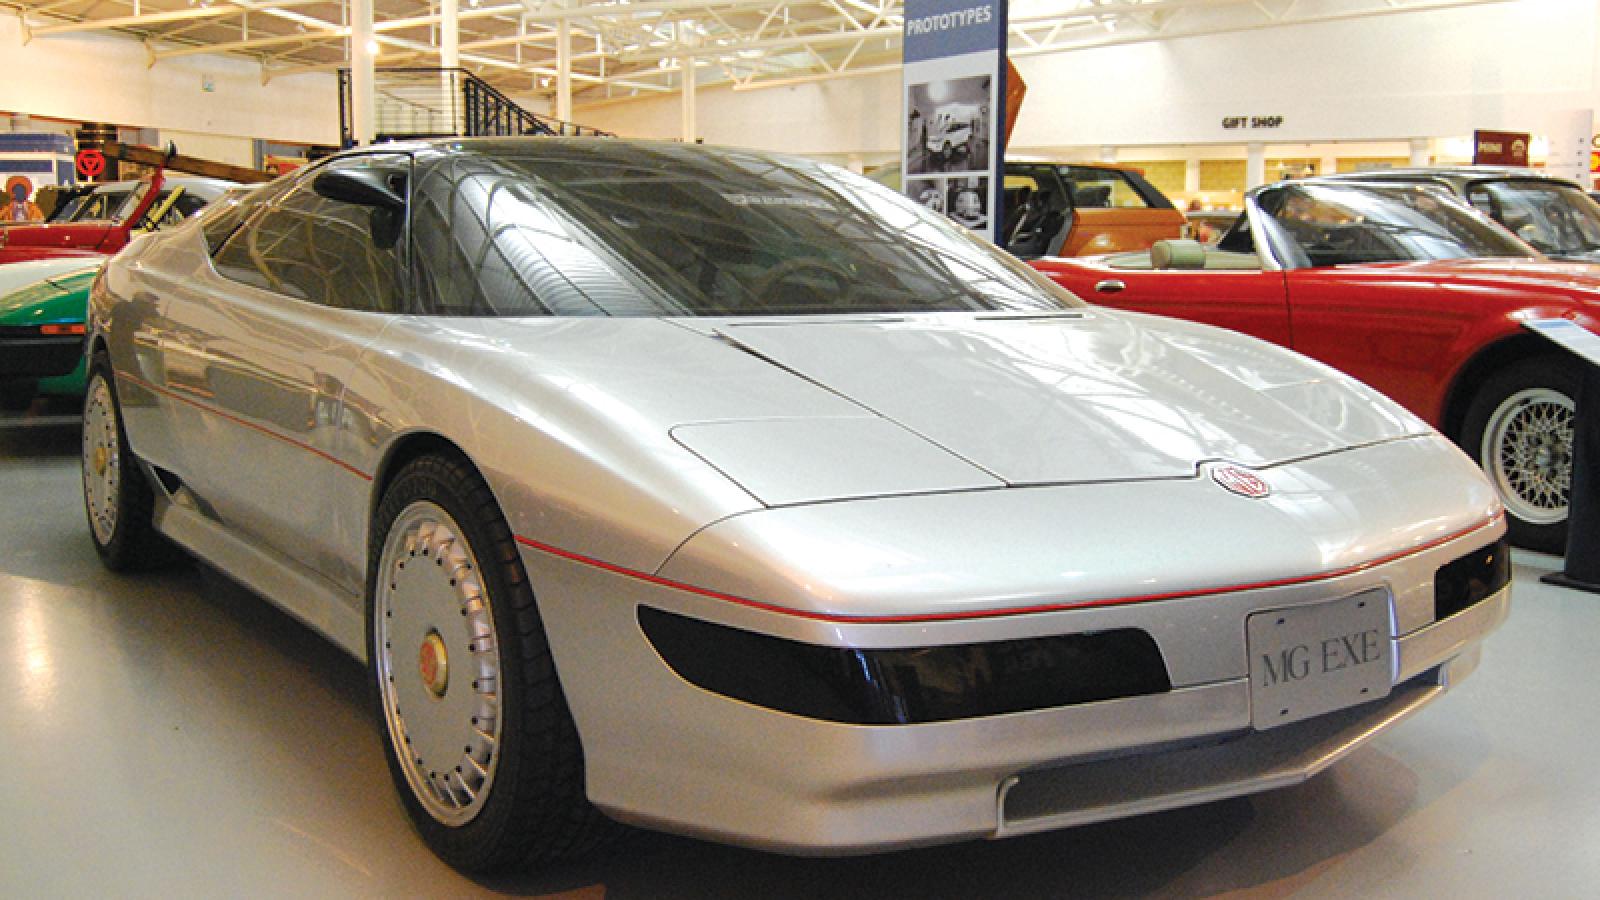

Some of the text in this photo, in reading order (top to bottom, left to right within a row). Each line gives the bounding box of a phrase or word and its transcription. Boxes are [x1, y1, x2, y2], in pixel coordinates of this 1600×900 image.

[907, 4, 992, 36] PROTOTYPES
[1222, 115, 1284, 129] GIFT SHOP
[1262, 629, 1380, 686] MG EXE
